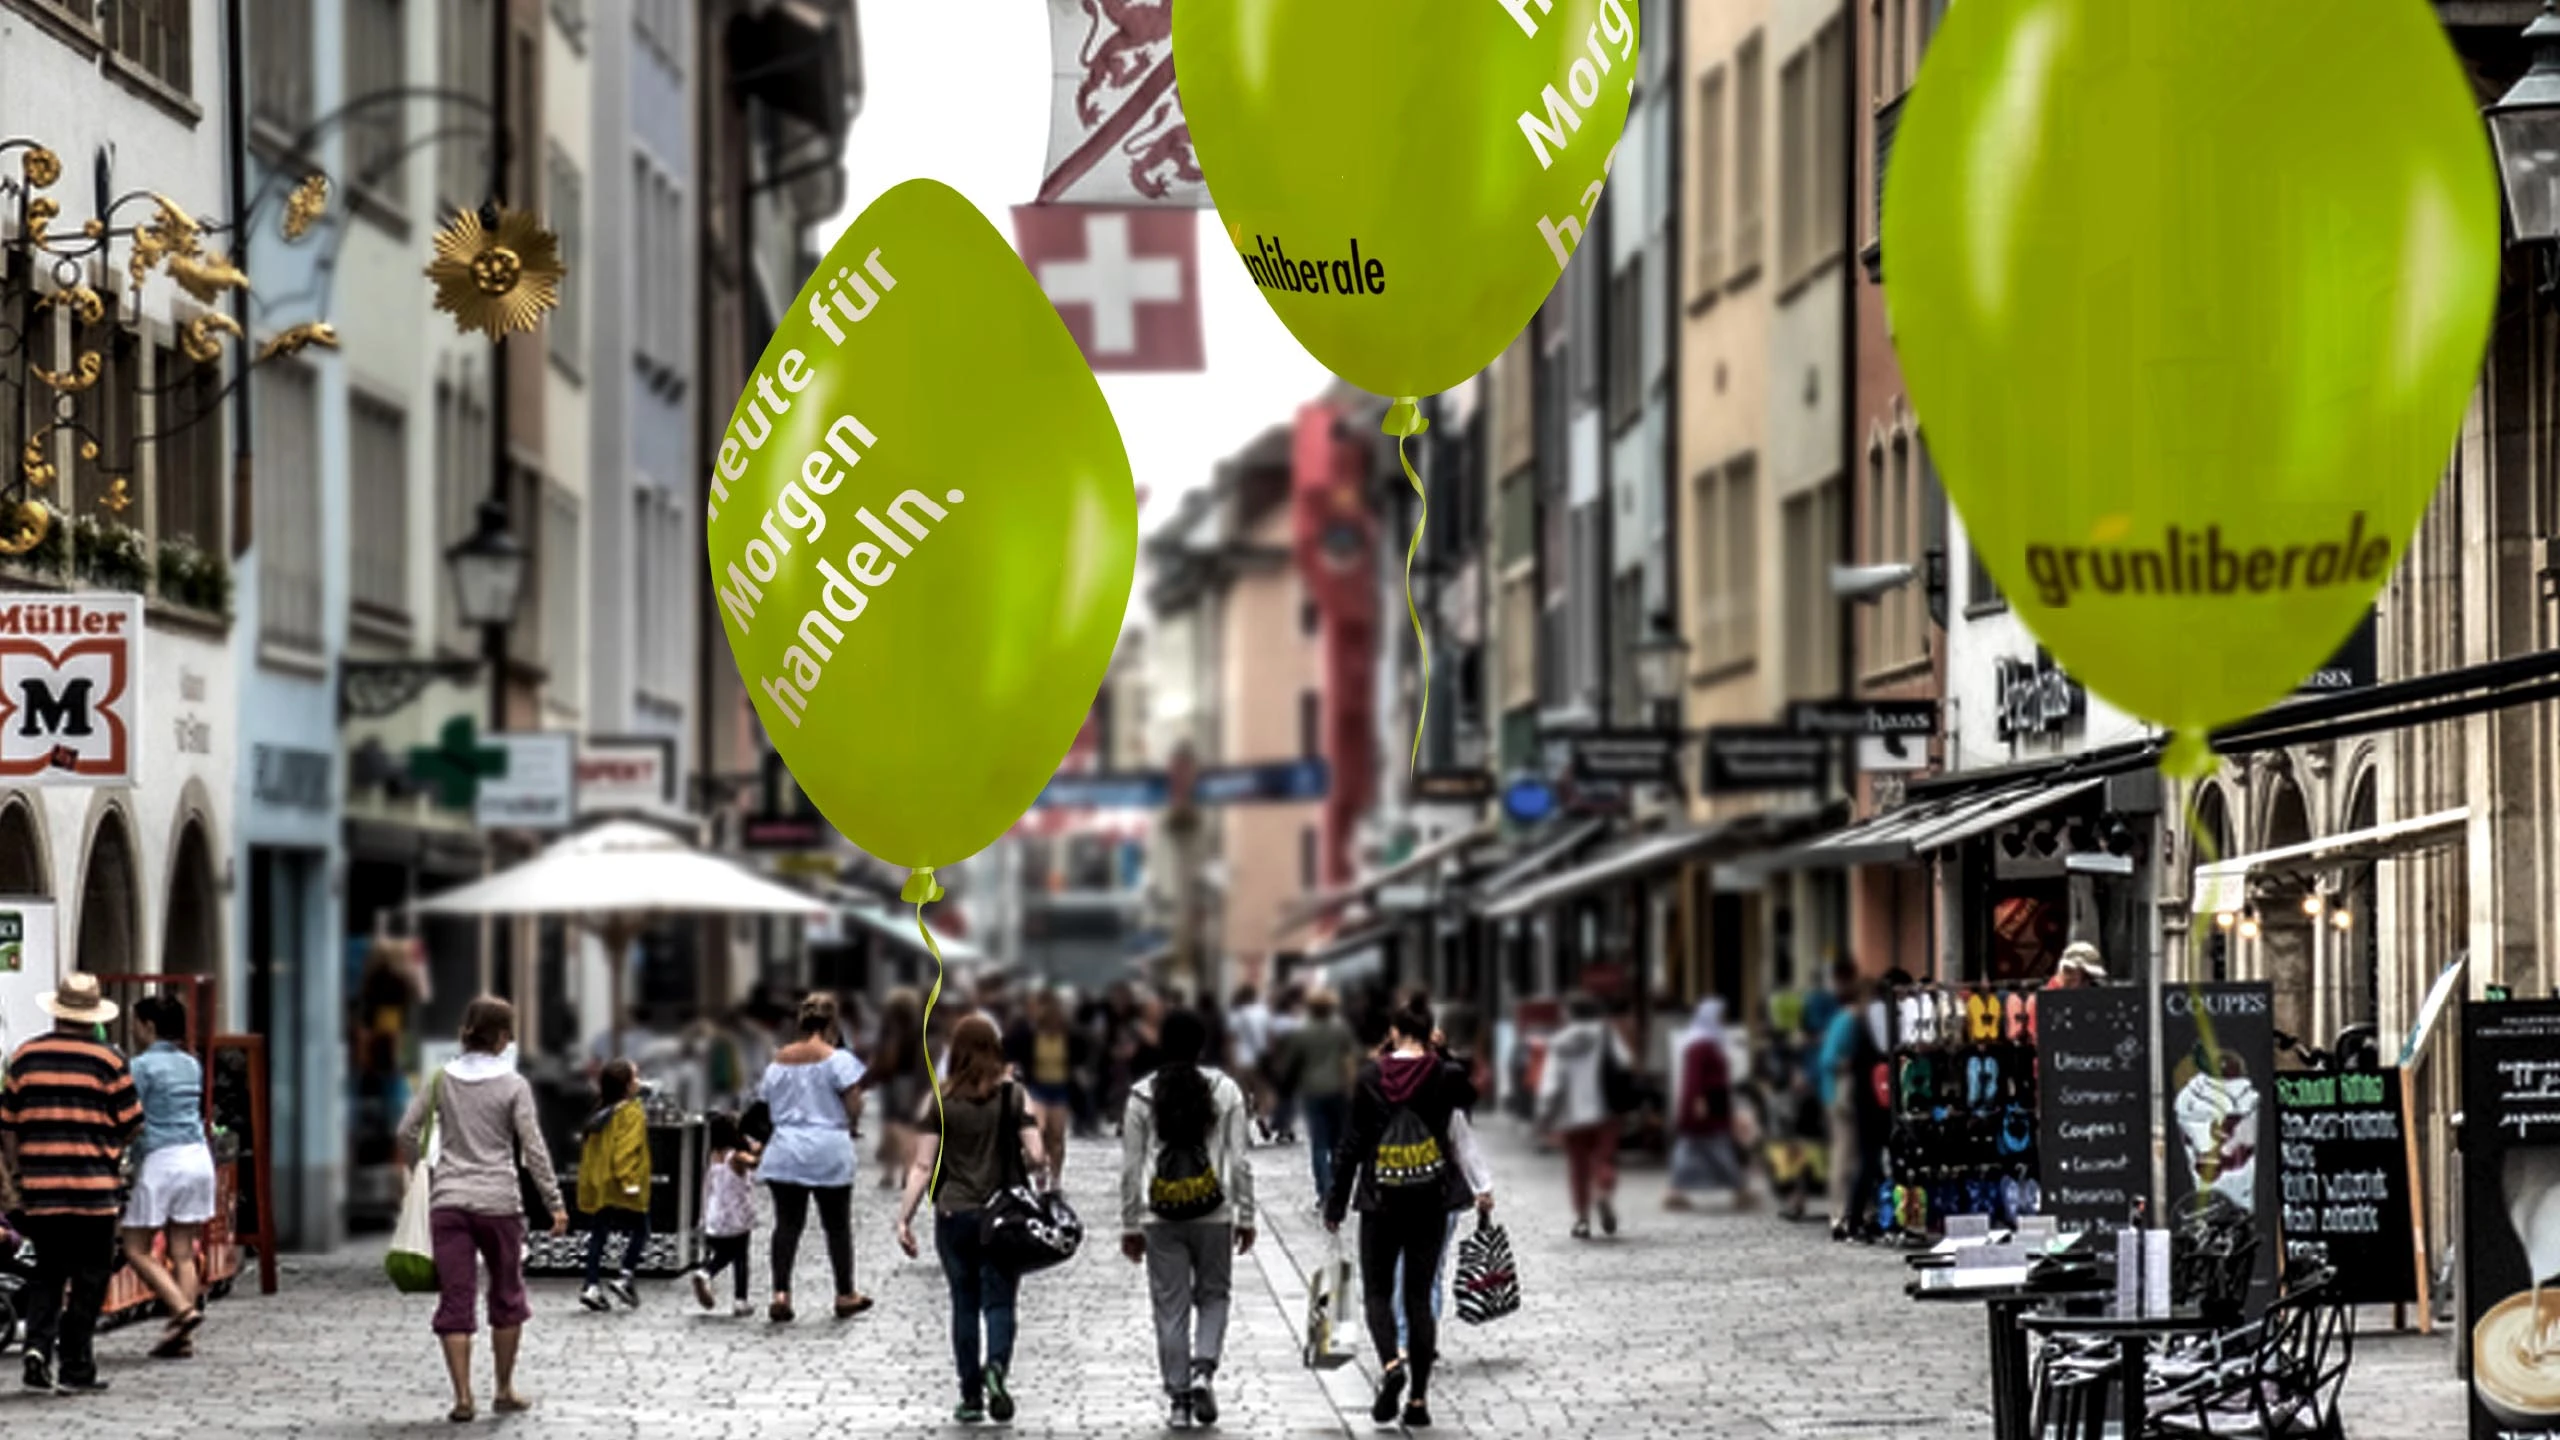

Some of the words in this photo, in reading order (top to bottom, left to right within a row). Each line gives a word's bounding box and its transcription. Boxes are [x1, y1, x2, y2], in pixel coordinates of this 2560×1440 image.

[1516, 0, 1634, 171] Morg
[808, 246, 898, 347] für
[719, 414, 878, 636] Morgen
[0, 604, 127, 635] Müller
[760, 488, 966, 729] handeln.
[19, 678, 94, 737] M
